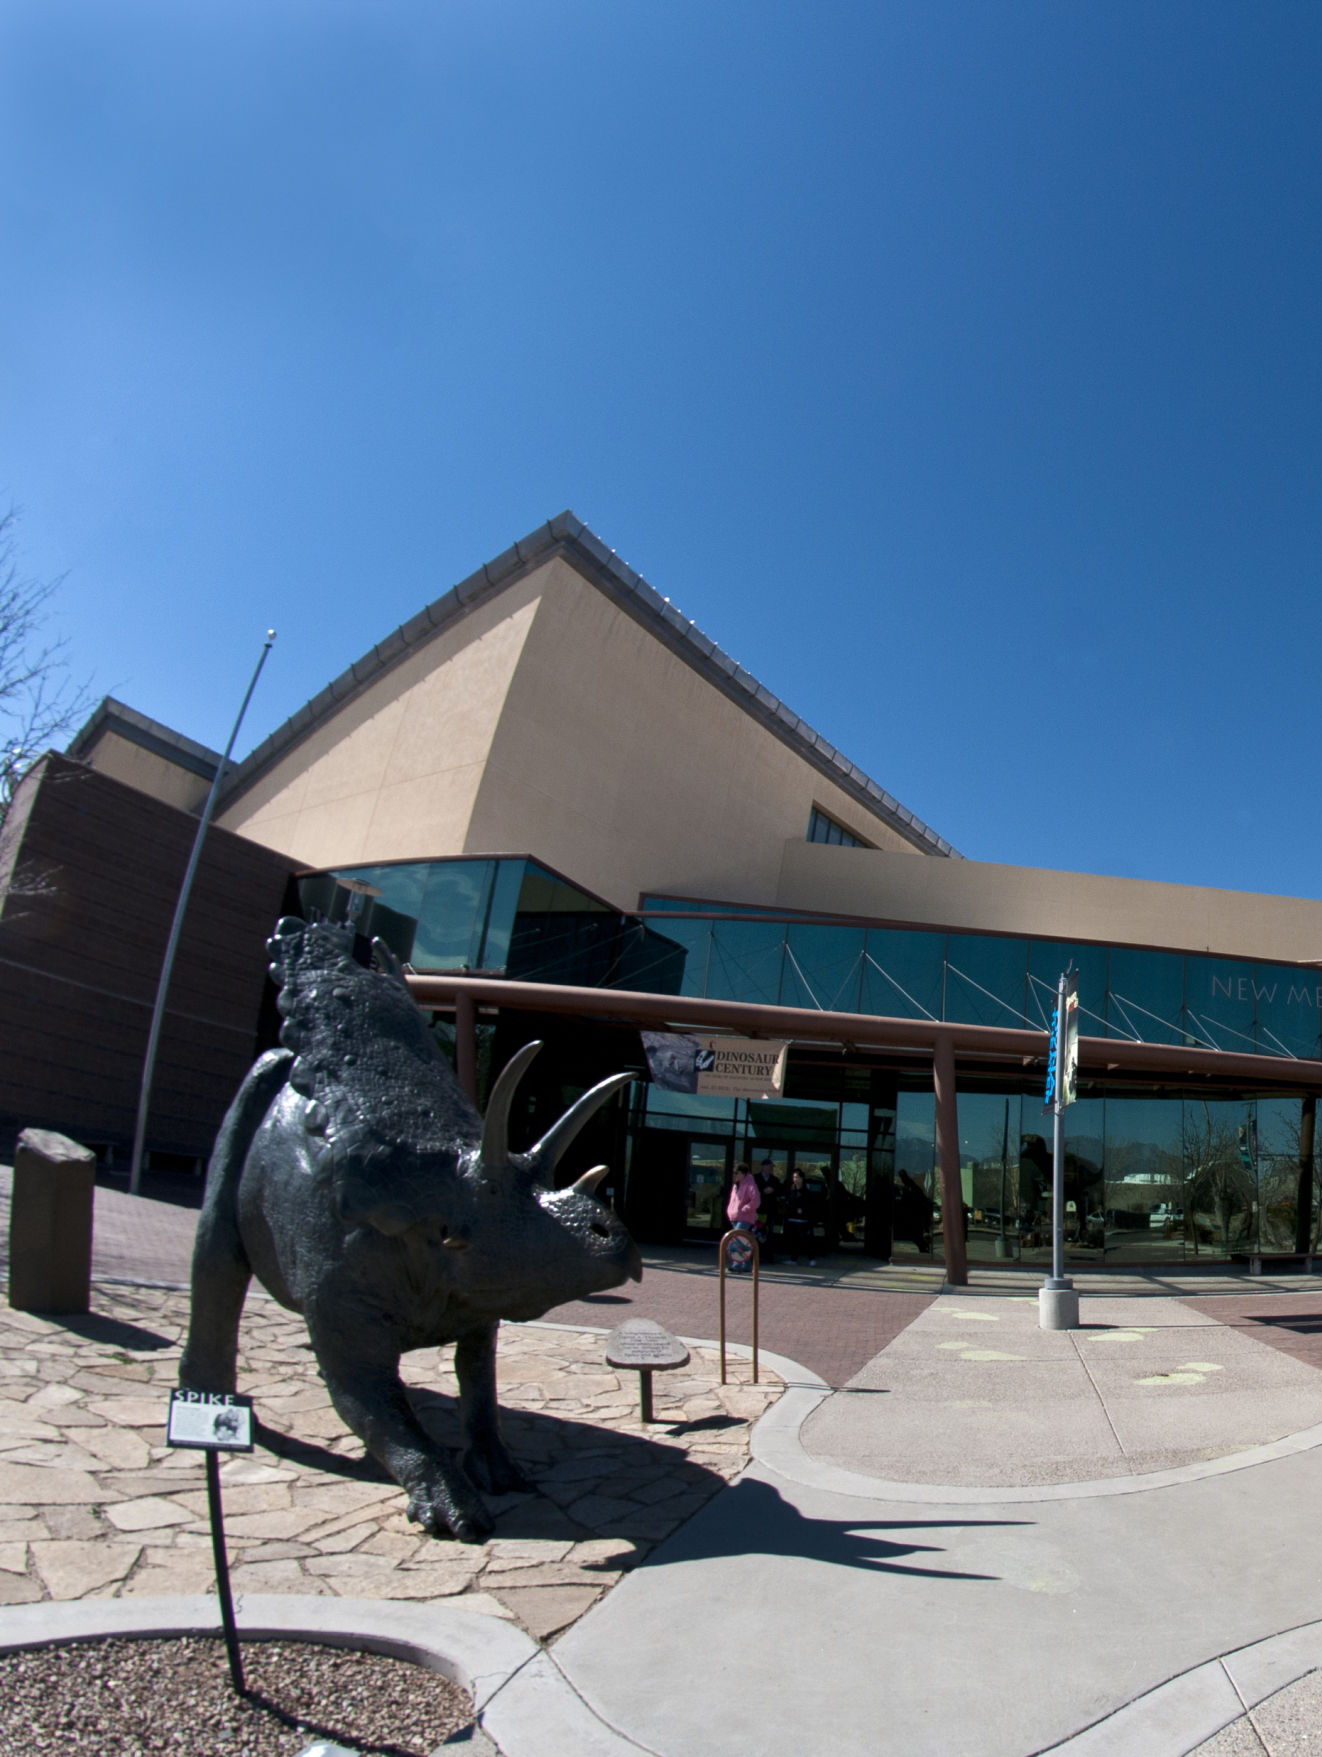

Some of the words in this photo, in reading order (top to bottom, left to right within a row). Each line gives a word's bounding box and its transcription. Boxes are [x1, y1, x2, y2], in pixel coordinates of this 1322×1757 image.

[1211, 975, 1277, 1003] NEW
[717, 1051, 780, 1065] DINOSAUR
[715, 1063, 774, 1077] CENTURY
[174, 1390, 235, 1406] SPIKE
